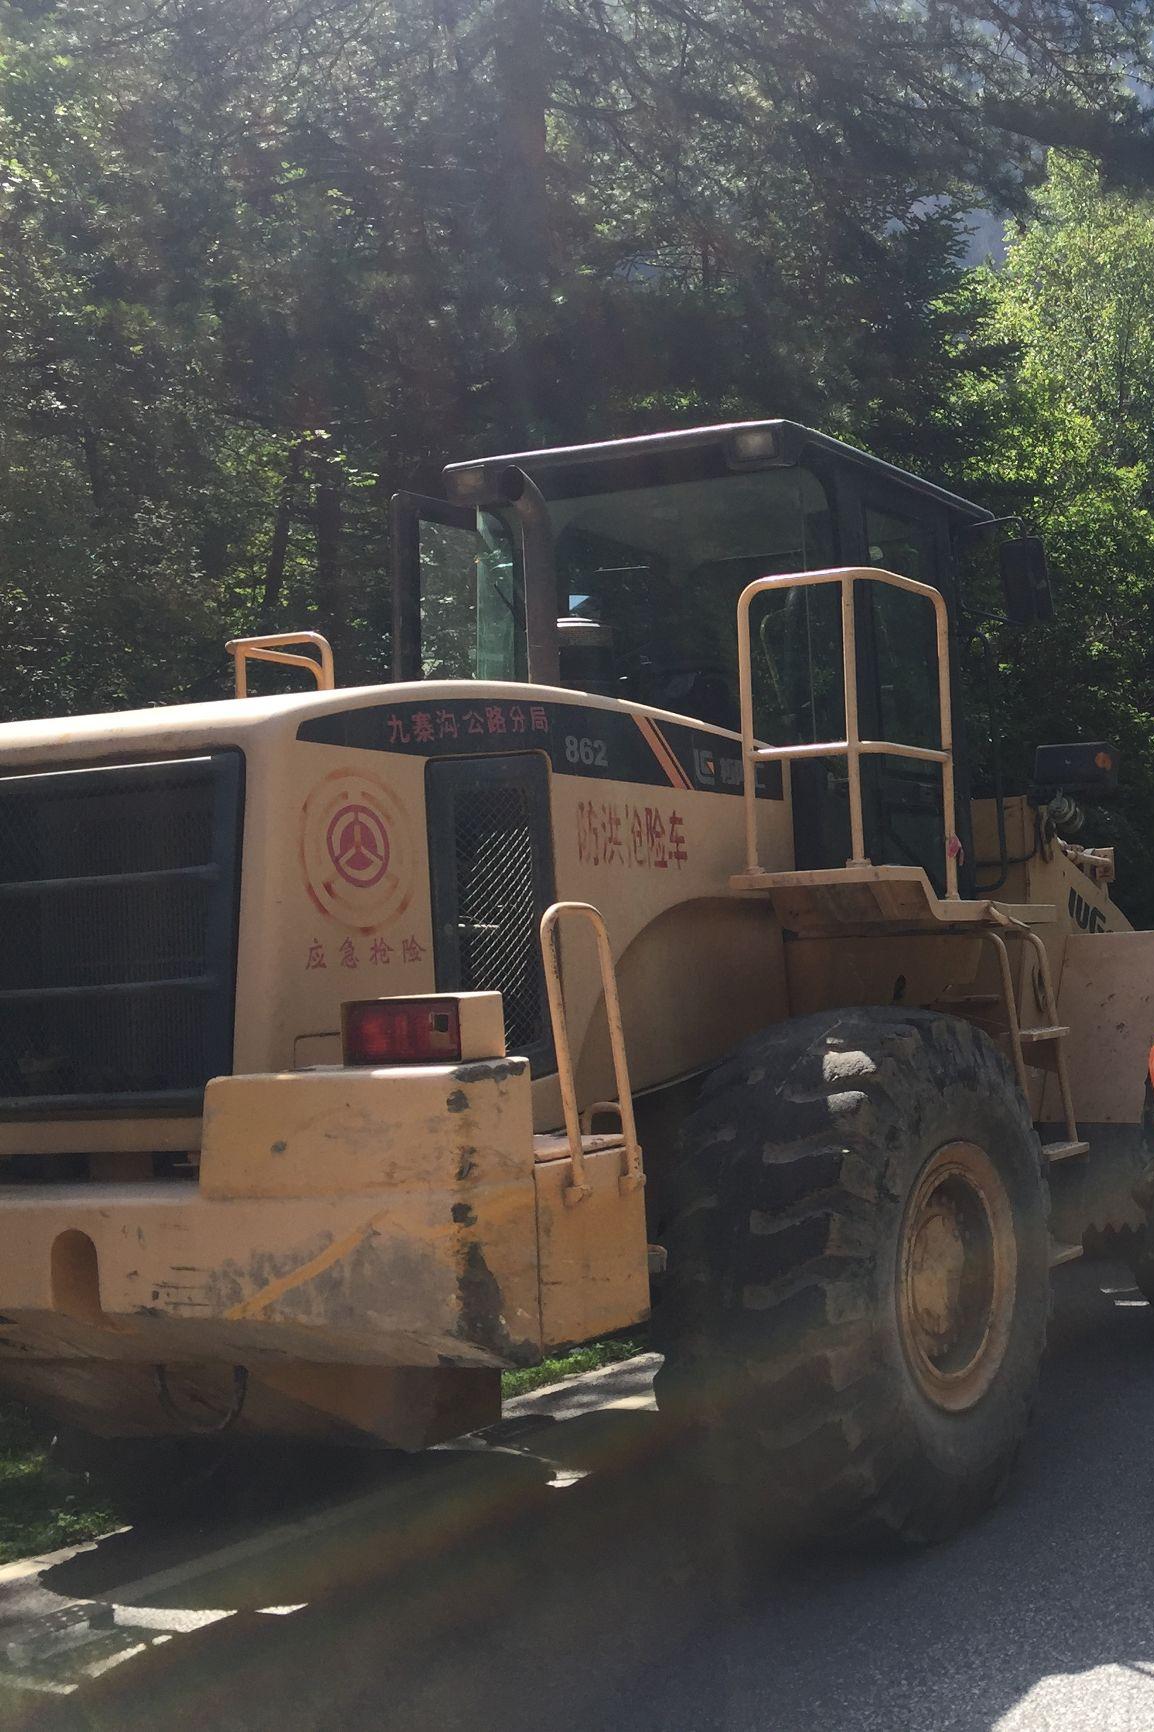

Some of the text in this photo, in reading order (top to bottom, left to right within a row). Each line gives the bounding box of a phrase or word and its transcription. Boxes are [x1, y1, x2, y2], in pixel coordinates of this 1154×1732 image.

[387, 705, 549, 744] 九寨沟公路分局
[565, 735, 609, 767] 862
[305, 934, 426, 970] 应急抢险
